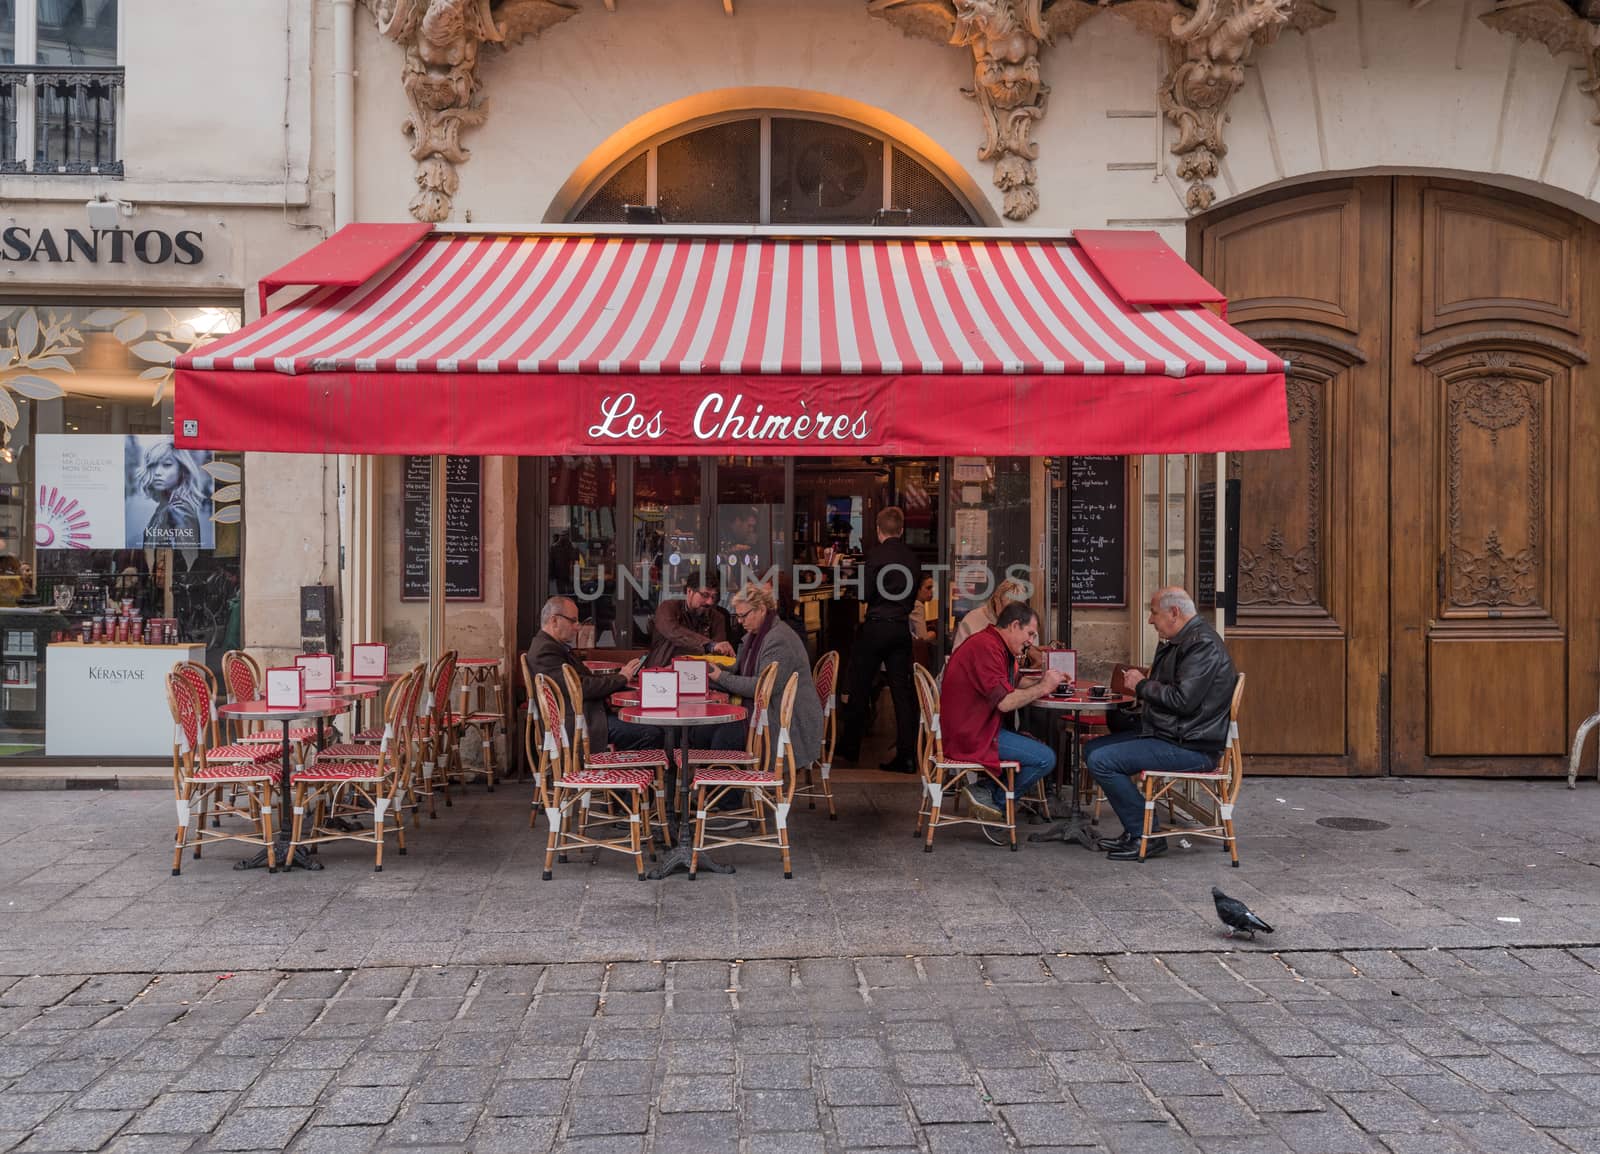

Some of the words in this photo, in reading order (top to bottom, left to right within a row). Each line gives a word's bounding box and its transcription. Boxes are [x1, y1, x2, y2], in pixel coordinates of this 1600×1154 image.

[0, 226, 205, 265] SANTOS
[588, 393, 667, 439] Les
[693, 393, 872, 440] Chimères
[89, 666, 145, 680] KÉRASTASE
